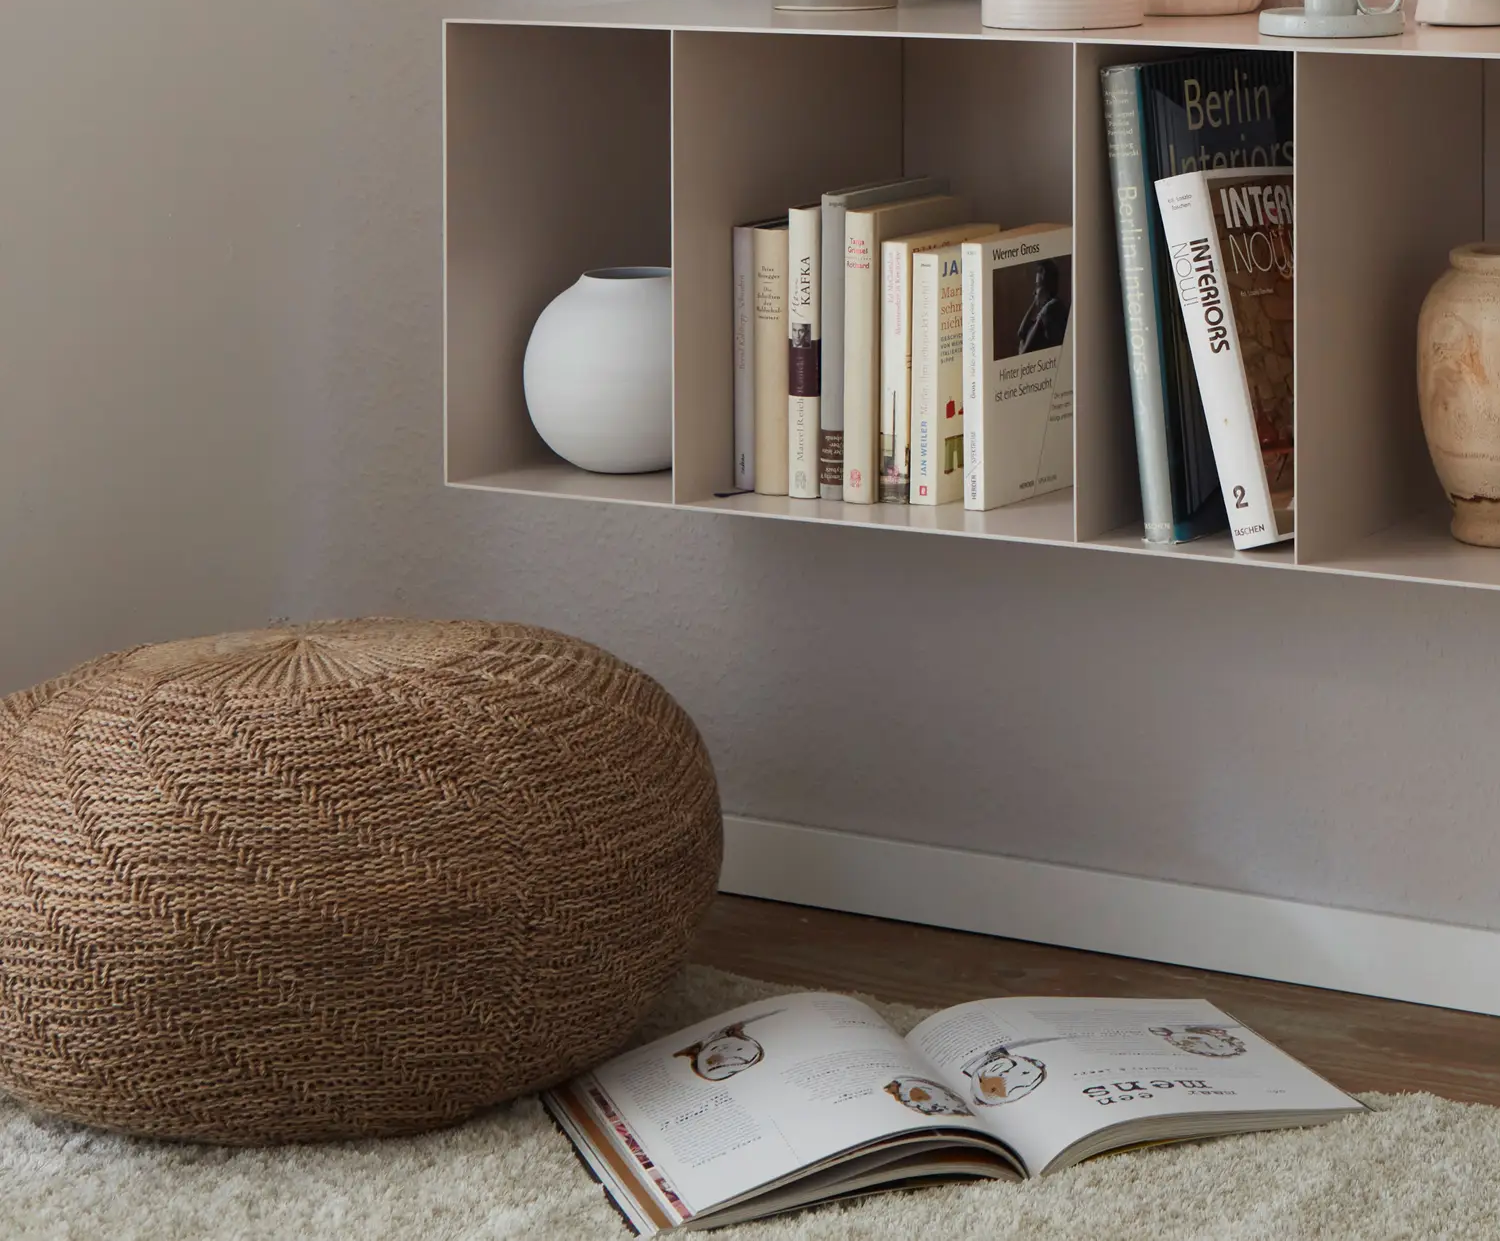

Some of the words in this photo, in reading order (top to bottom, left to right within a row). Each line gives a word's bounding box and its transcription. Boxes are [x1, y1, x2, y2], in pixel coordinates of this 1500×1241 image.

[1184, 68, 1271, 131] Berlin
[1117, 186, 1143, 258] Berlin
[992, 247, 1019, 261] Werner
[1020, 242, 1040, 256] Gross
[942, 258, 962, 277] JA
[800, 256, 811, 306] KAFKA
[1189, 237, 1231, 354] INTERIORS
[1124, 266, 1149, 375] Interiors
[999, 367, 1019, 381] Hinter
[1019, 363, 1036, 380] jeder
[1037, 357, 1057, 373] Sucht
[994, 390, 1003, 402] ist
[1004, 386, 1018, 400] eine
[1018, 377, 1053, 397] Sehnsucht
[1233, 485, 1249, 509] 2
[1234, 524, 1265, 537] TASCHEN
[1081, 1079, 1212, 1100] mens
